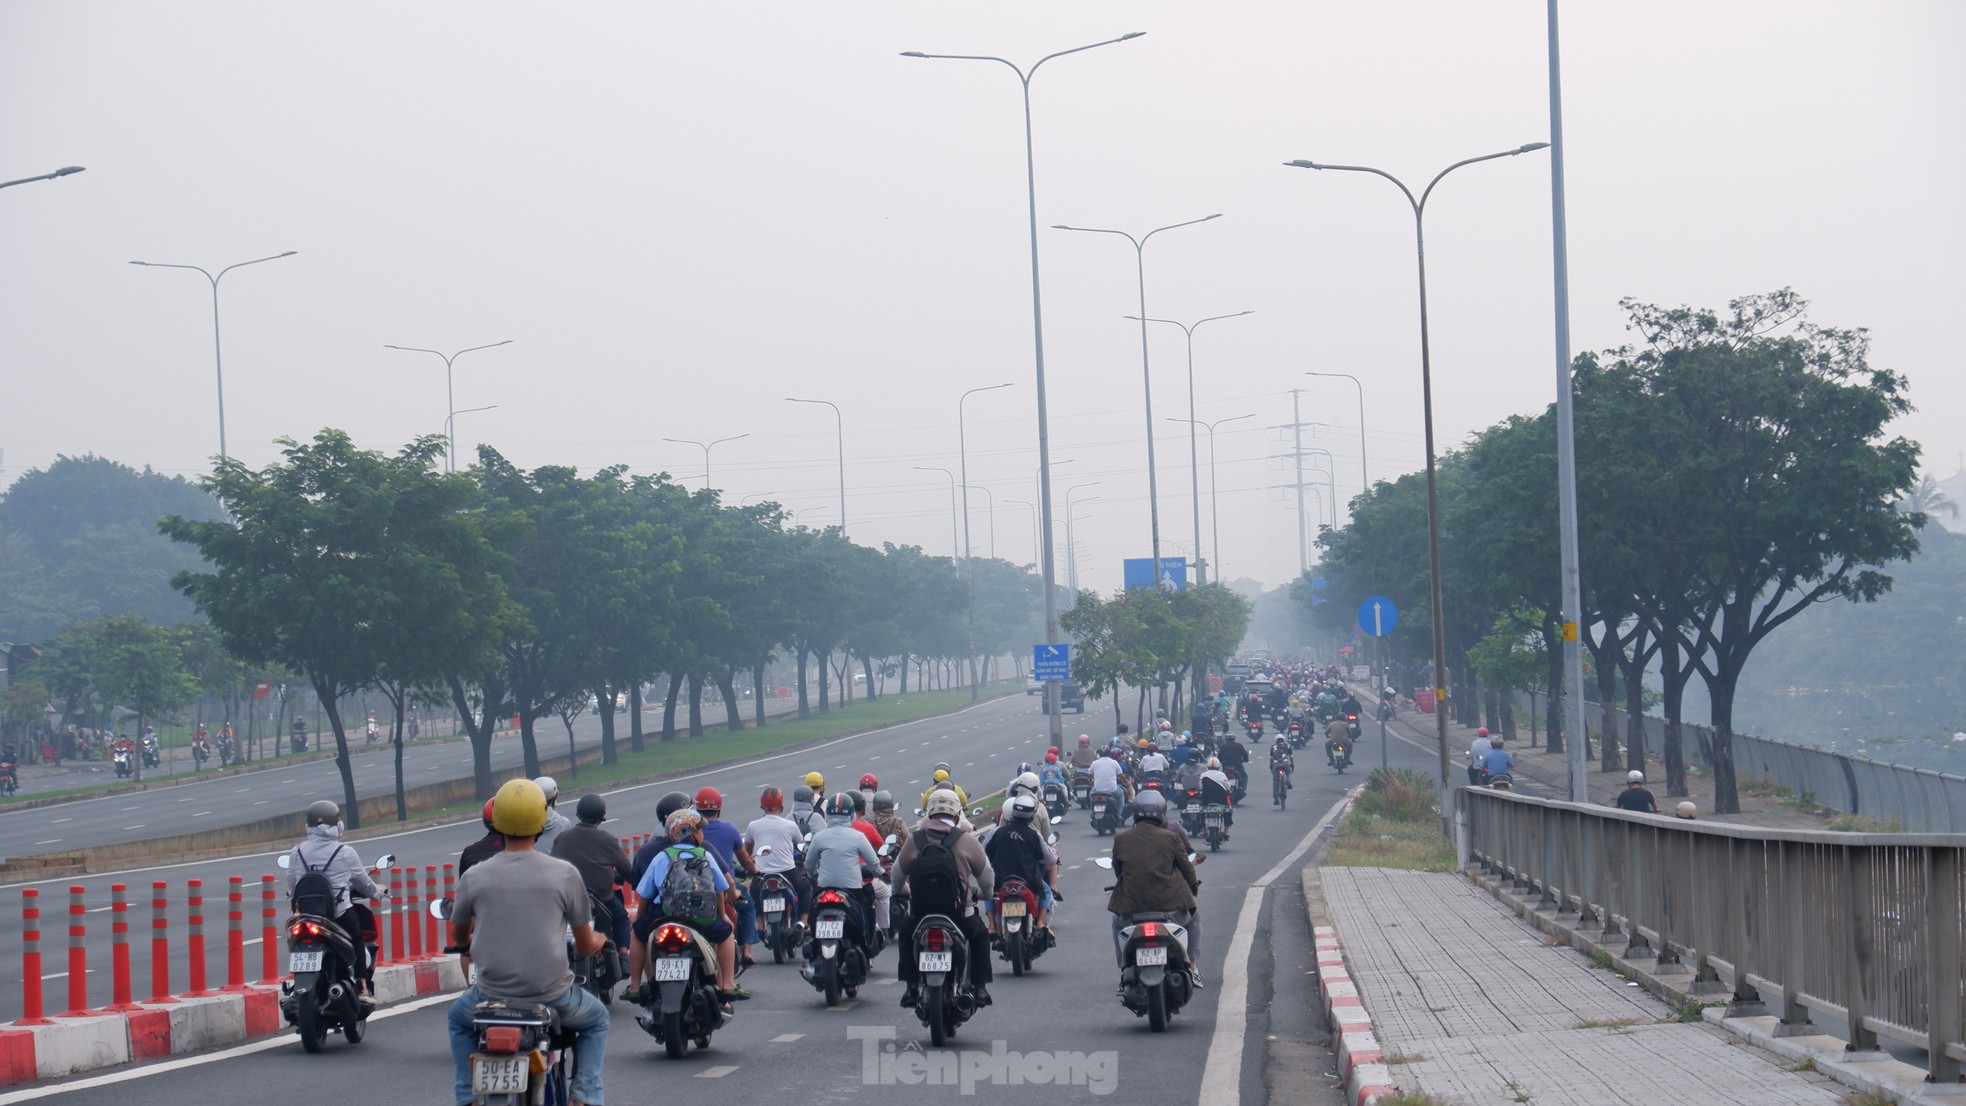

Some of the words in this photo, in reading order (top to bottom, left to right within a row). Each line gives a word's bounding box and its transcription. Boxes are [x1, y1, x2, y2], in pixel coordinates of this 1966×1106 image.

[293, 962, 317, 971] 0289
[661, 959, 683, 969] 59-K1
[658, 970, 686, 980] 774.21
[481, 1060, 520, 1074] 50-EA
[481, 1075, 520, 1091] 5755
